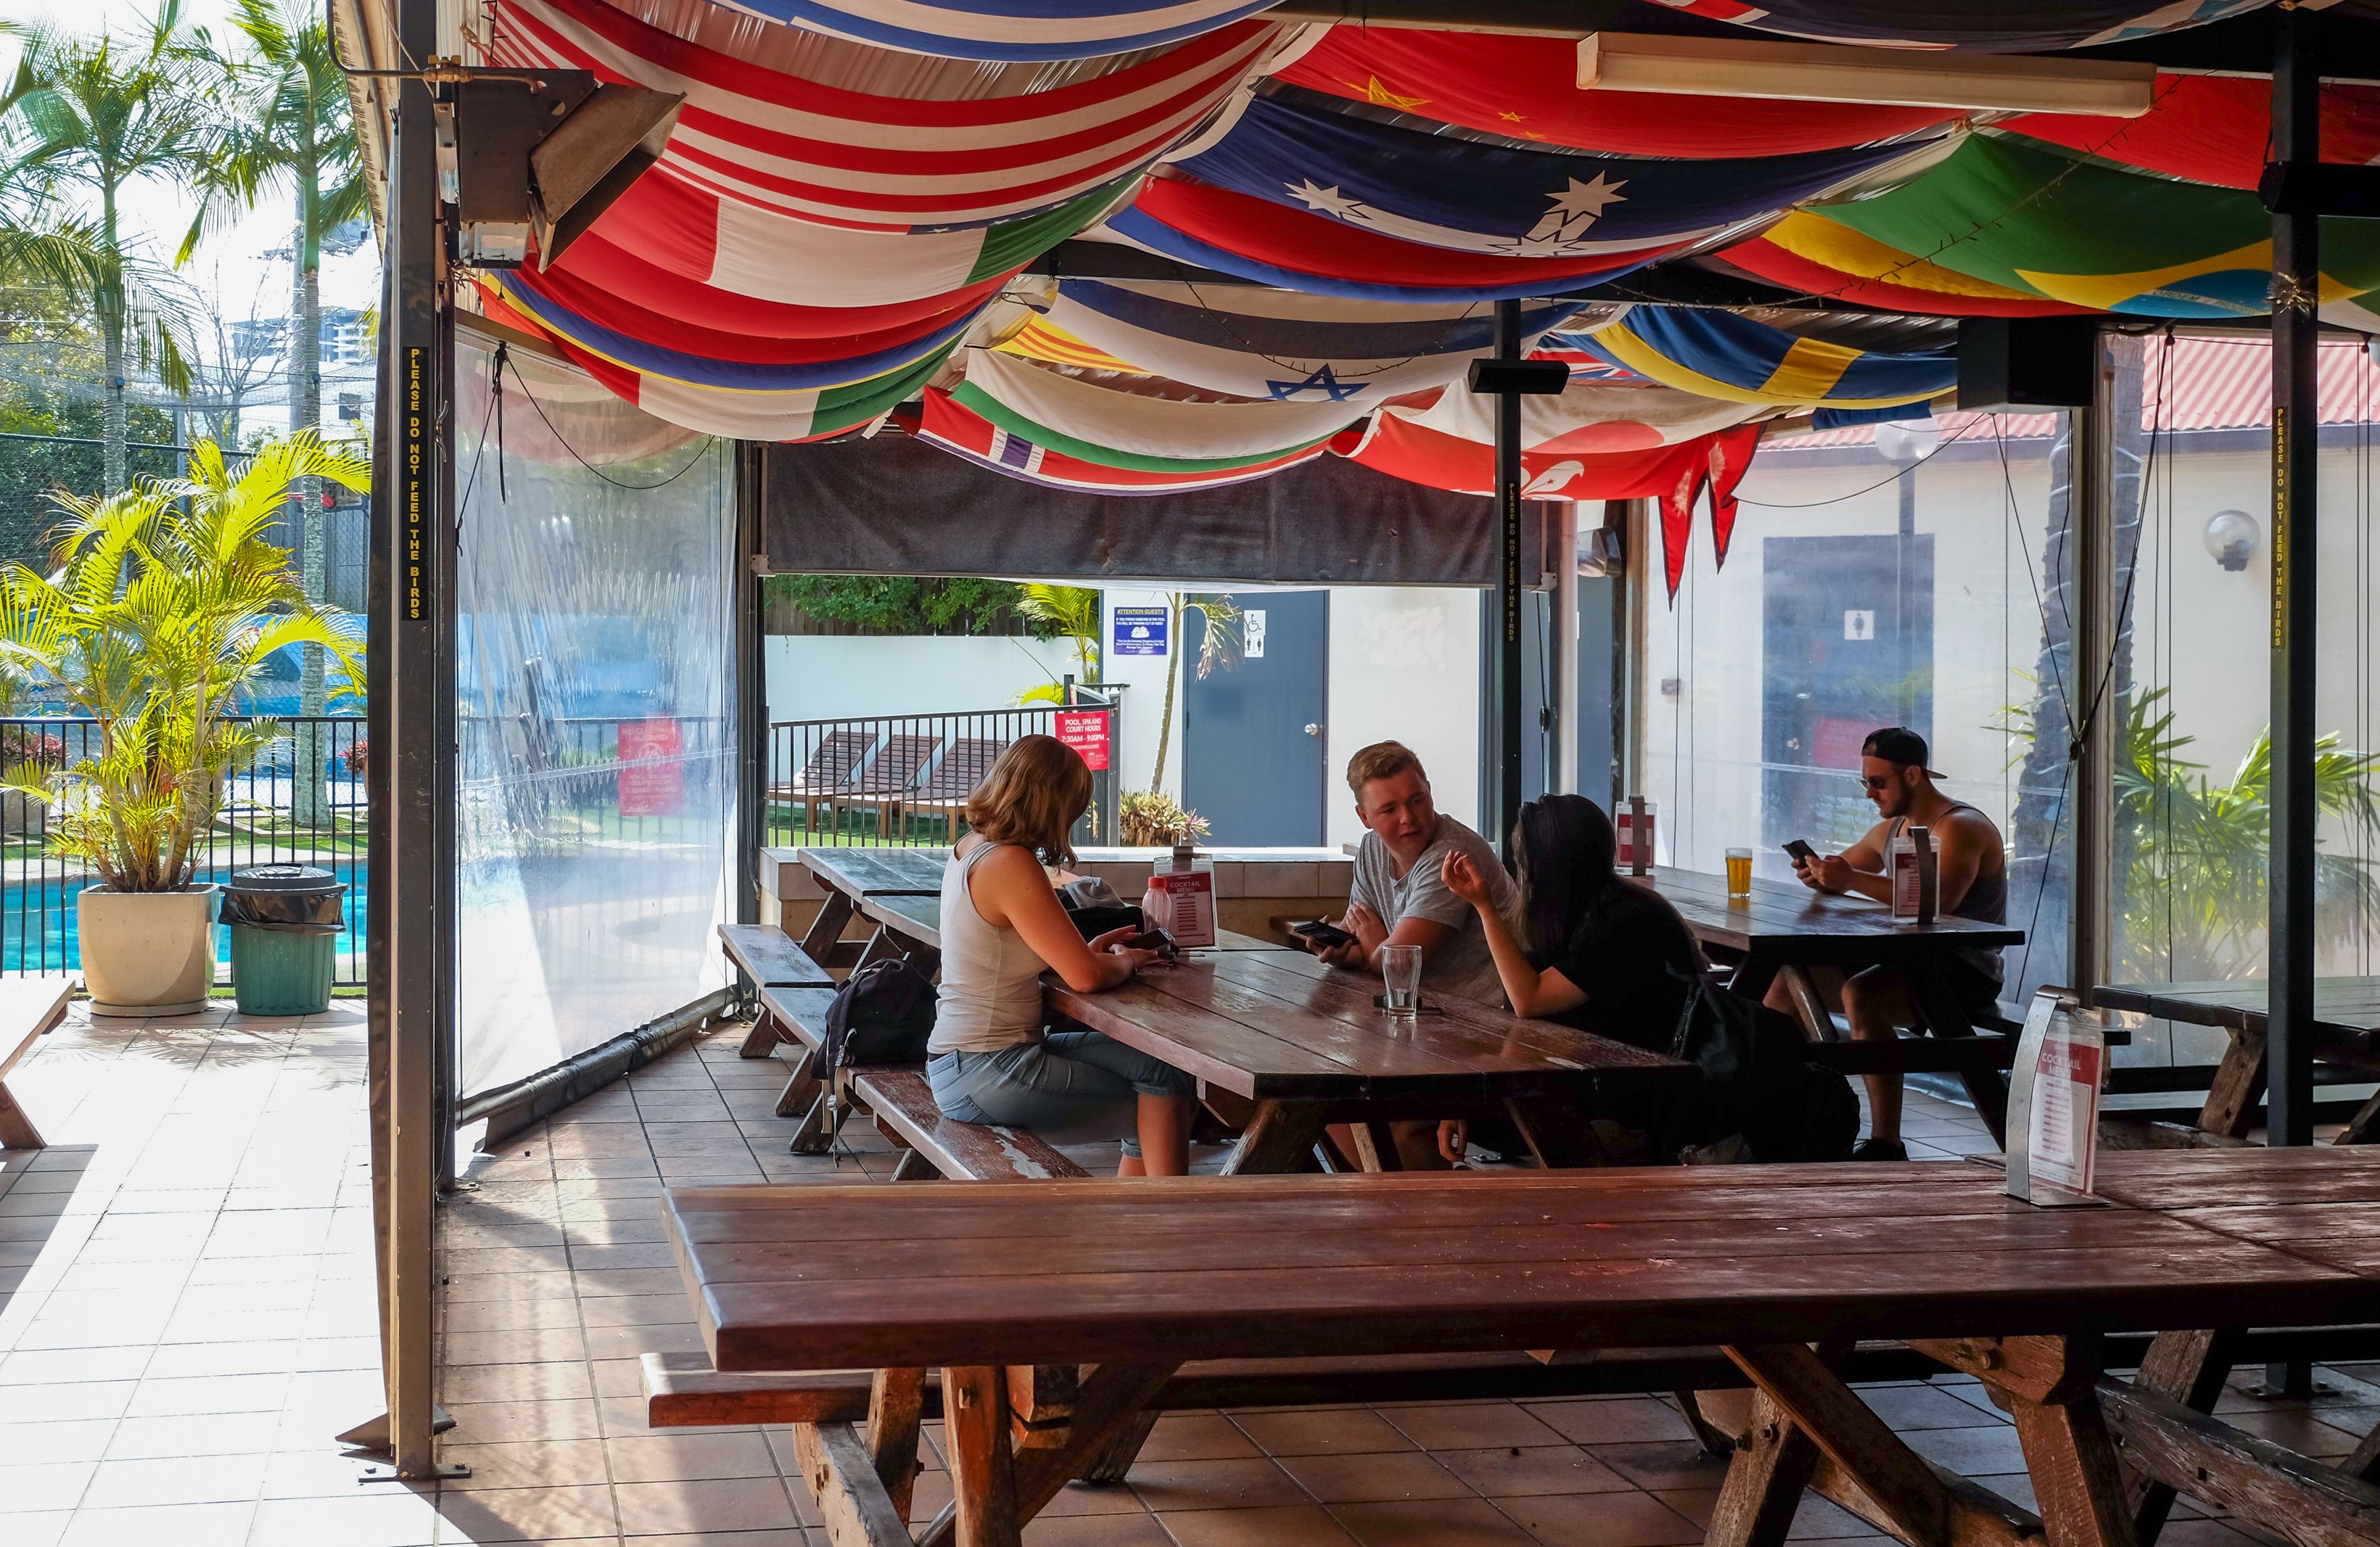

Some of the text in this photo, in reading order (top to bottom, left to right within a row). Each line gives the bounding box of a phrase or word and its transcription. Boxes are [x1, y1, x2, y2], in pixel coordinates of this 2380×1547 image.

[410, 349, 420, 619] PLEASE DO NOT FEED THE BIRDS
[2277, 469, 2284, 487] DO
[1510, 523, 1515, 535] DO
[1061, 735, 1083, 743] 7:30AM
[2041, 1052, 2082, 1070] COCKTAIL
[2048, 1065, 2071, 1078] MENU
